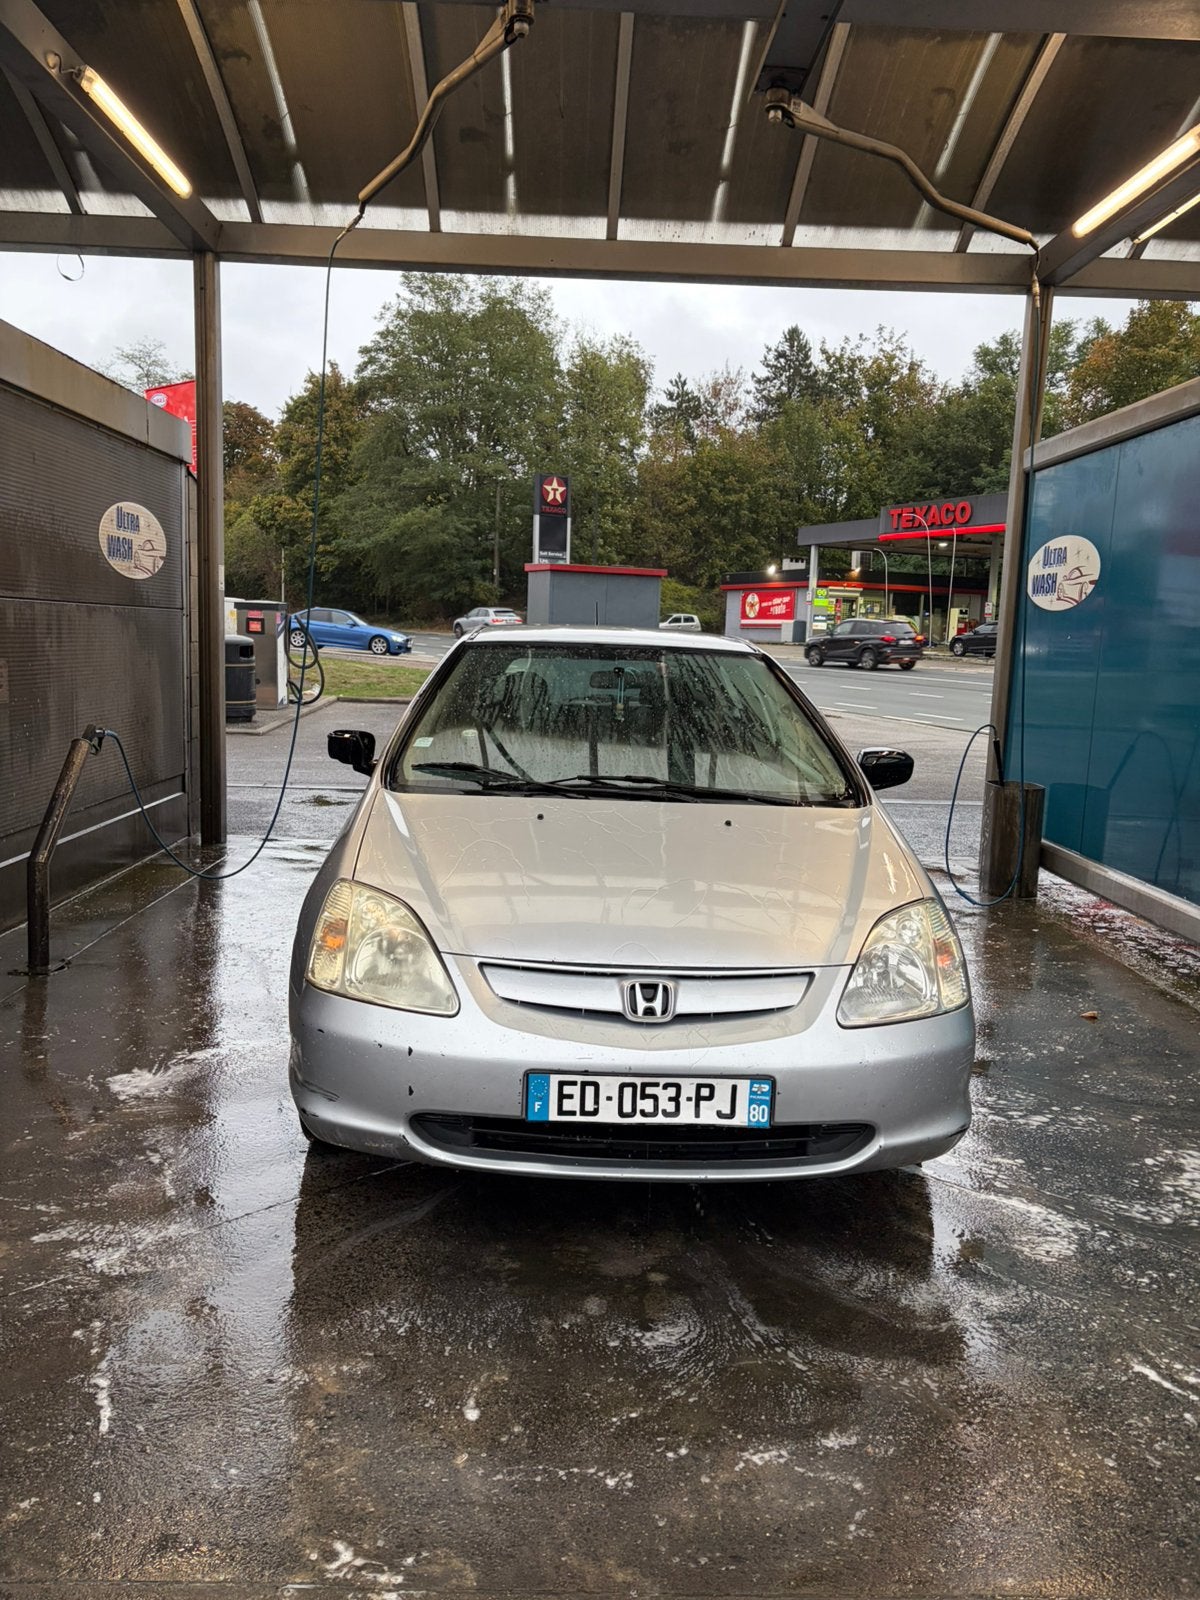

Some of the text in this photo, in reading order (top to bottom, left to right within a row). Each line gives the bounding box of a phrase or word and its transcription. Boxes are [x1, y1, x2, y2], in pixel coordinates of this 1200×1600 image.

[115, 505, 140, 533] ULTRA
[541, 505, 567, 514] TEXACO
[889, 501, 972, 529] TEXACO
[106, 534, 133, 560] WASH
[1042, 545, 1068, 567] ULTRA
[1031, 572, 1058, 595] WASH
[534, 1101, 542, 1113] F
[557, 1080, 738, 1120] ED-053-PJ
[750, 1104, 768, 1123] 80
